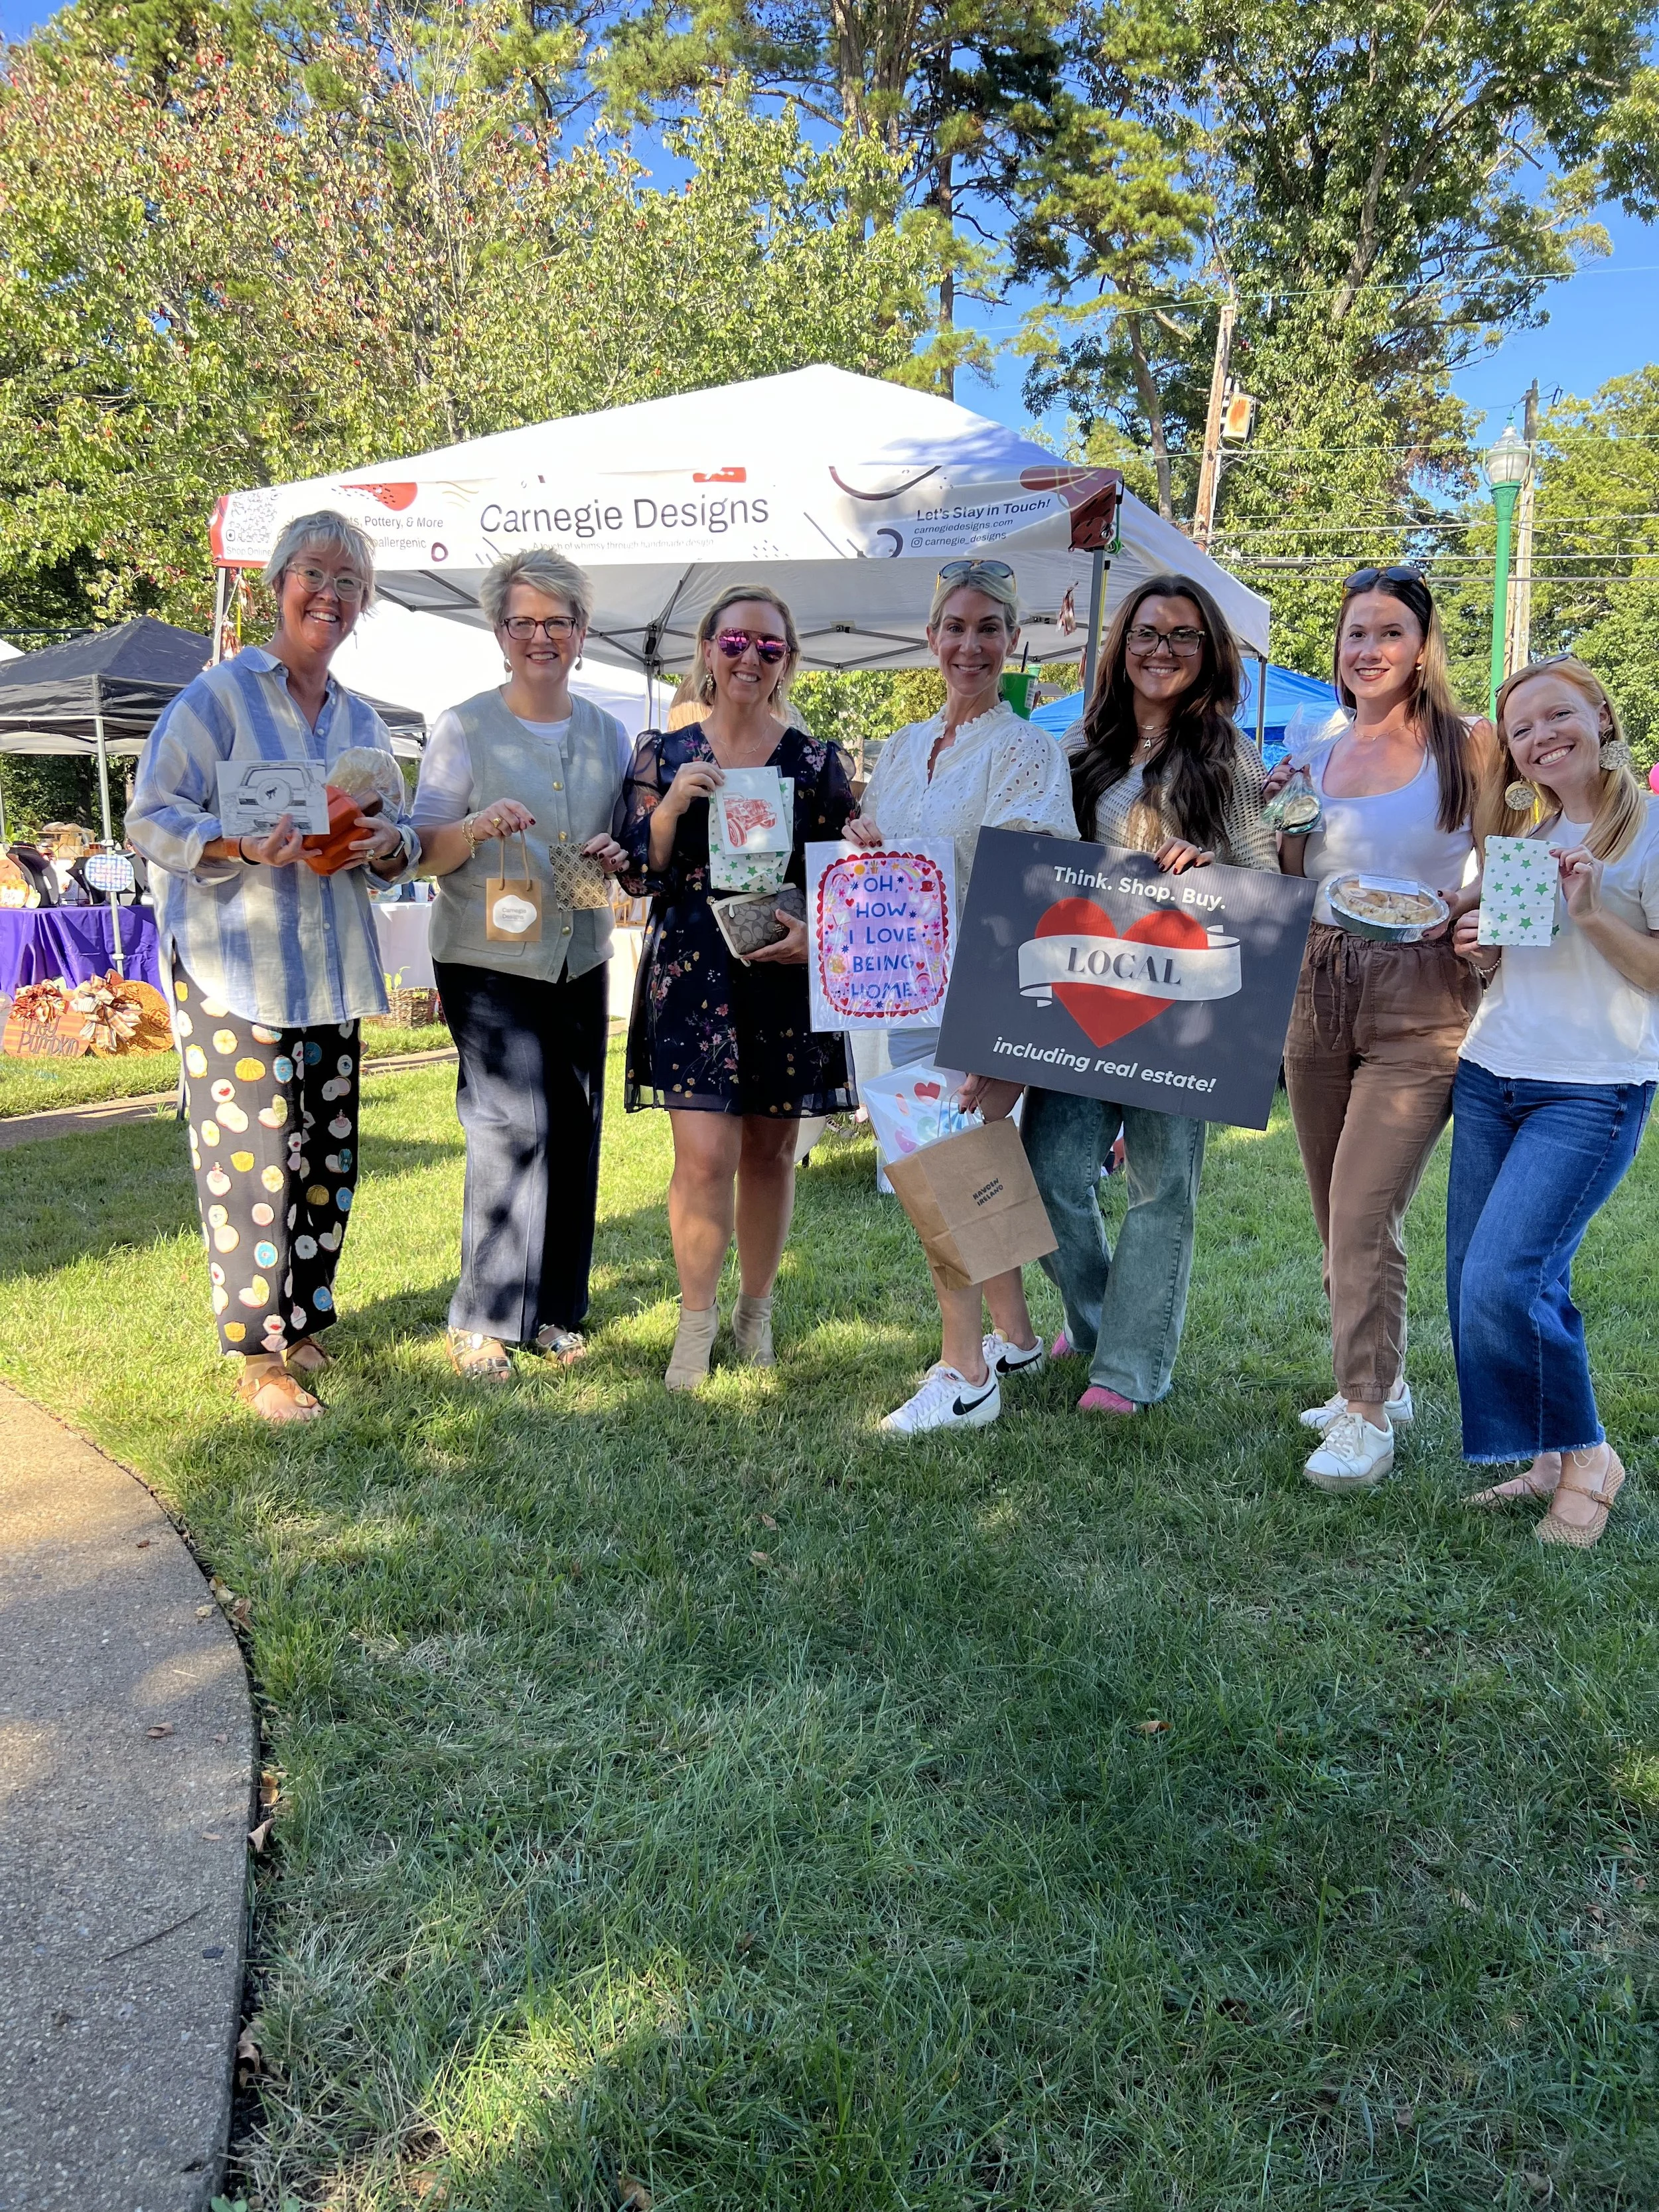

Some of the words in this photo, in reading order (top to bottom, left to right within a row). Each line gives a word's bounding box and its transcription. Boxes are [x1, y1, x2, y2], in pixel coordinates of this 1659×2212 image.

[480, 499, 623, 538] Carnegie
[634, 494, 769, 533] Designs
[917, 509, 949, 521] Let's
[987, 504, 999, 516] in
[1003, 499, 1051, 514] Touch!
[364, 516, 404, 530] Pottery,
[406, 517, 414, 527] &
[417, 517, 444, 528] More
[914, 519, 1013, 534] carnegiedesigns.com
[575, 541, 606, 552] whimsy
[607, 539, 638, 550] through
[925, 532, 1007, 546] carnegie_designs
[226, 546, 246, 555] Shop
[1143, 739, 1151, 748] A
[863, 875, 899, 893] OH,
[1053, 866, 1112, 891] Think.
[1118, 877, 1176, 902] Shop.
[1182, 888, 1226, 911] Buy.
[856, 902, 906, 918] HOW
[849, 929, 853, 944] I
[866, 926, 916, 944] LOVE
[853, 954, 914, 972] BEING
[1066, 946, 1182, 985] LOCAL
[851, 982, 917, 999] HOME.
[993, 1036, 1091, 1071] including
[1094, 1059, 1139, 1079] real
[1141, 1067, 1217, 1092] estate!
